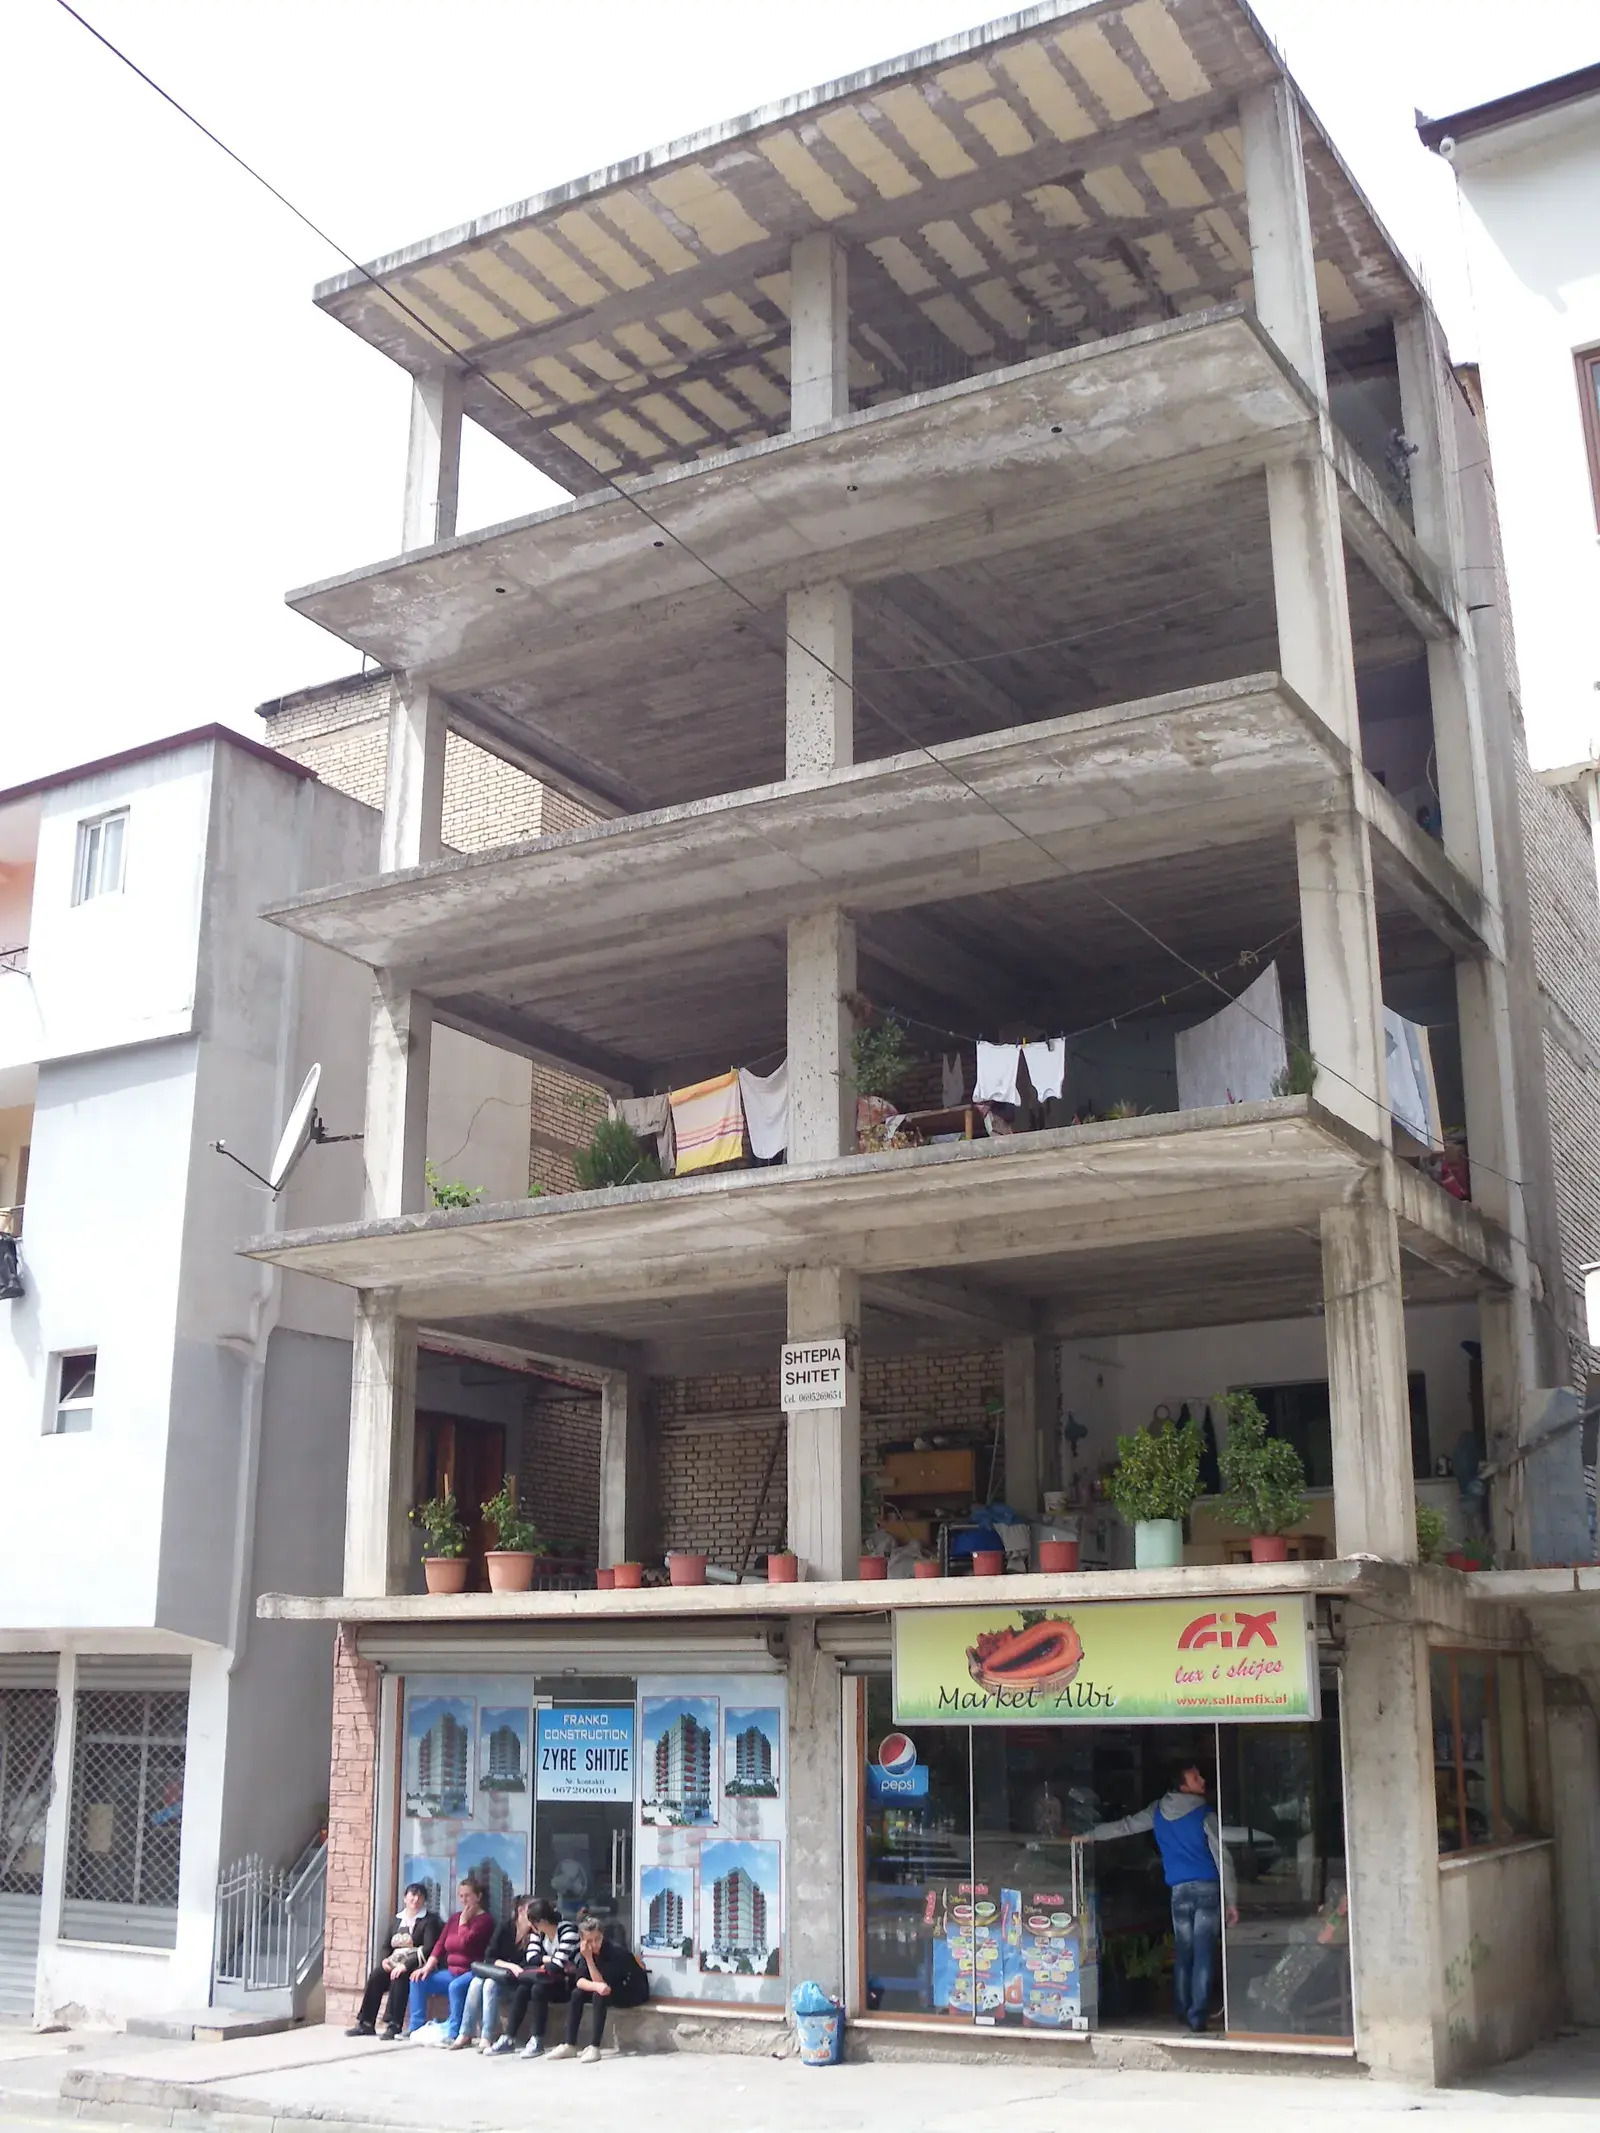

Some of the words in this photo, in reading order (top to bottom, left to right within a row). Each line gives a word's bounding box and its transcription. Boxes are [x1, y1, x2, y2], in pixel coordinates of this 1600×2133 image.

[784, 1347, 841, 1365] SHTEPIA
[785, 1368, 840, 1385] SHITET
[1175, 1665, 1203, 1684] lux
[1212, 1664, 1220, 1680] i
[1226, 1657, 1283, 1680] shijes
[938, 1684, 1042, 1711] Market
[1055, 1682, 1116, 1709] Albi
[1177, 1694, 1287, 1706] www.sallamfix.al
[563, 1714, 608, 1725] FRANKO
[544, 1729, 628, 1740] CONSTRUCTION
[542, 1748, 577, 1771] ZYRE
[585, 1748, 628, 1771] SHITJE
[881, 1777, 915, 1792] pepsi
